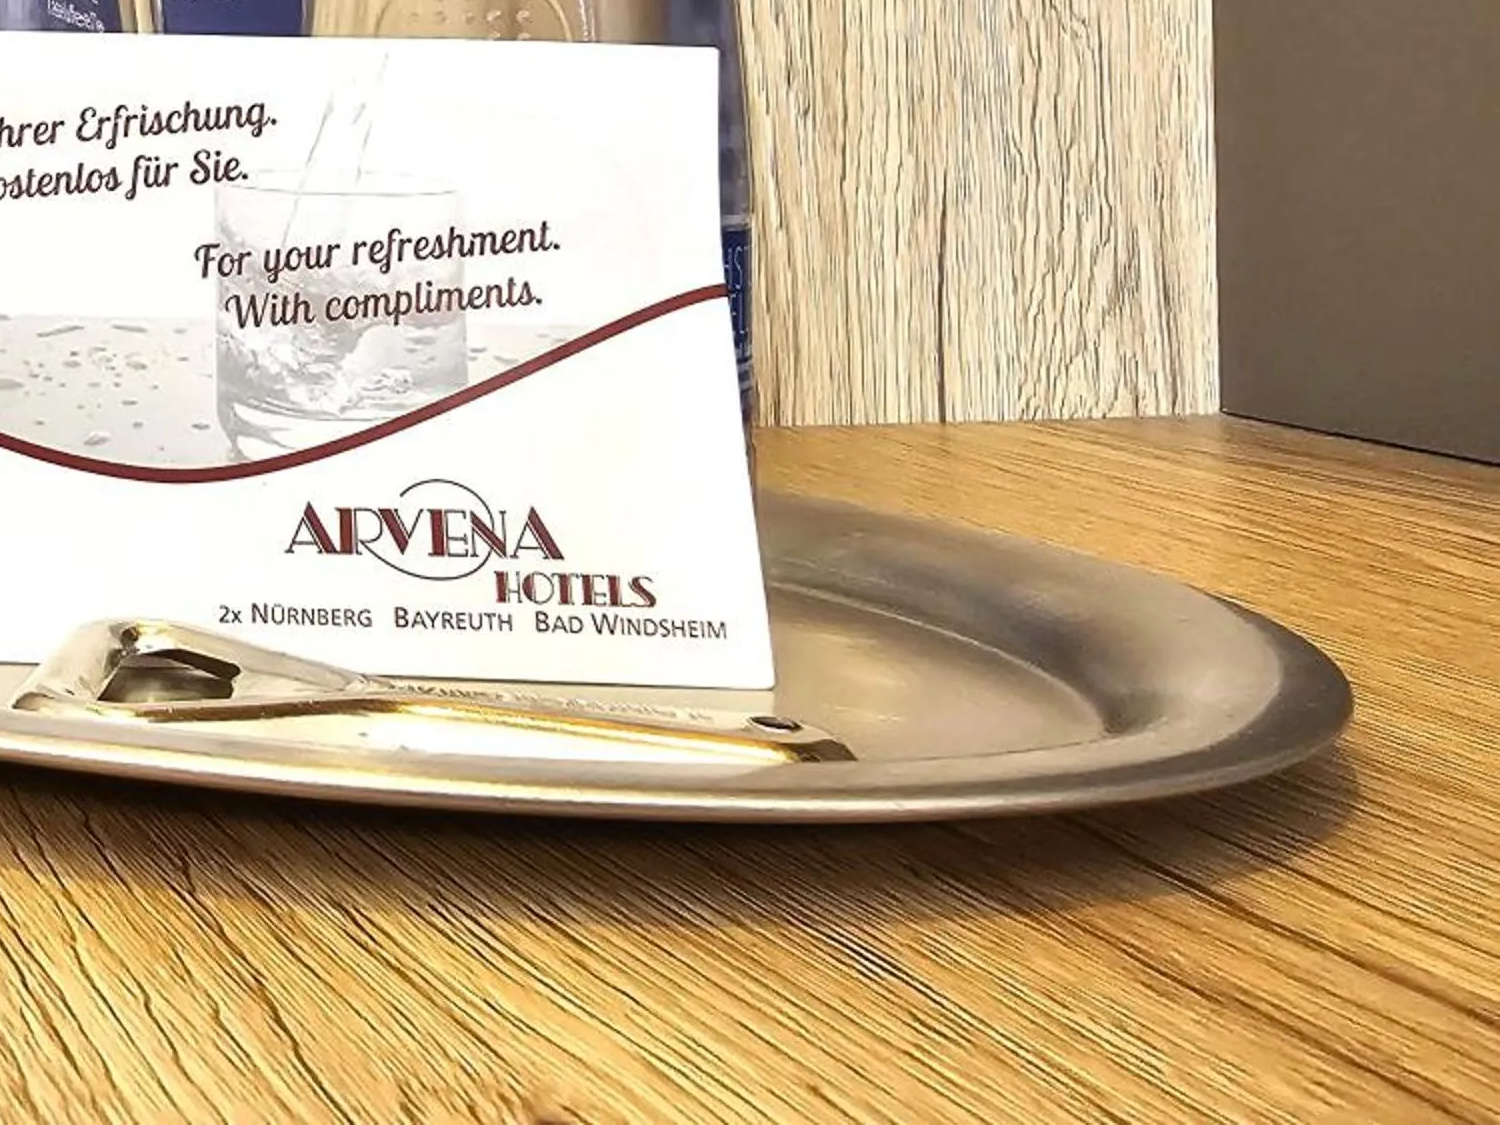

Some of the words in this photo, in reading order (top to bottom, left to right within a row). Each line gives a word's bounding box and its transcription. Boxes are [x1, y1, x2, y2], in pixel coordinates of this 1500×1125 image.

[75, 101, 278, 150] Erfrischung.
[124, 155, 179, 200] für
[189, 149, 249, 185] Sie.
[194, 242, 251, 279] For
[263, 242, 341, 284] your
[351, 221, 561, 275] refreshment.
[225, 289, 316, 329] With
[326, 277, 543, 326] compliments.
[284, 500, 565, 560] ARVENA
[493, 570, 658, 608] HOTELS
[218, 605, 242, 625] 2x
[251, 602, 372, 629] NÜRNBERG
[394, 607, 514, 632] BAYREUTH
[535, 609, 583, 635] BAD
[593, 611, 728, 641] WINDSHEIM
